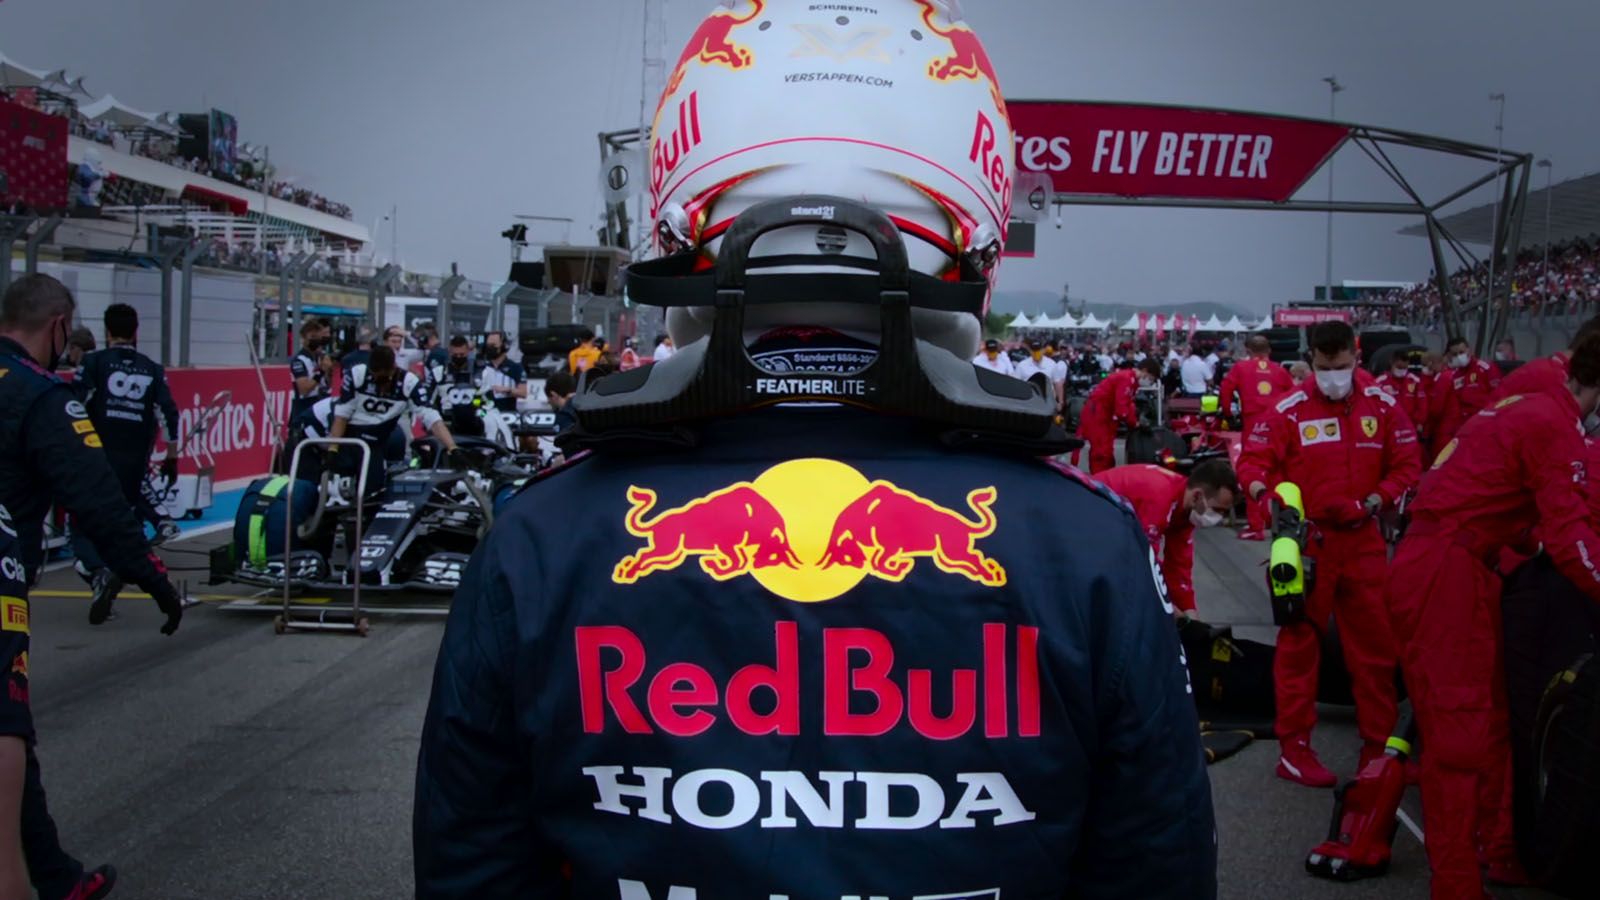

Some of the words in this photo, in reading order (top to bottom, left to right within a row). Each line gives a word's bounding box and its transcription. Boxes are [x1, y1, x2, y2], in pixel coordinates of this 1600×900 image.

[808, 4, 878, 15] SCHUBERTH
[784, 72, 893, 88] VERSTAPPEN.COM
[1091, 129, 1149, 174] FLY
[1154, 132, 1273, 179] BETTER
[756, 379, 865, 395] FEATHERLITE
[575, 620, 801, 737] Red
[823, 622, 1041, 741] Bull
[582, 765, 1037, 830] HONDA
